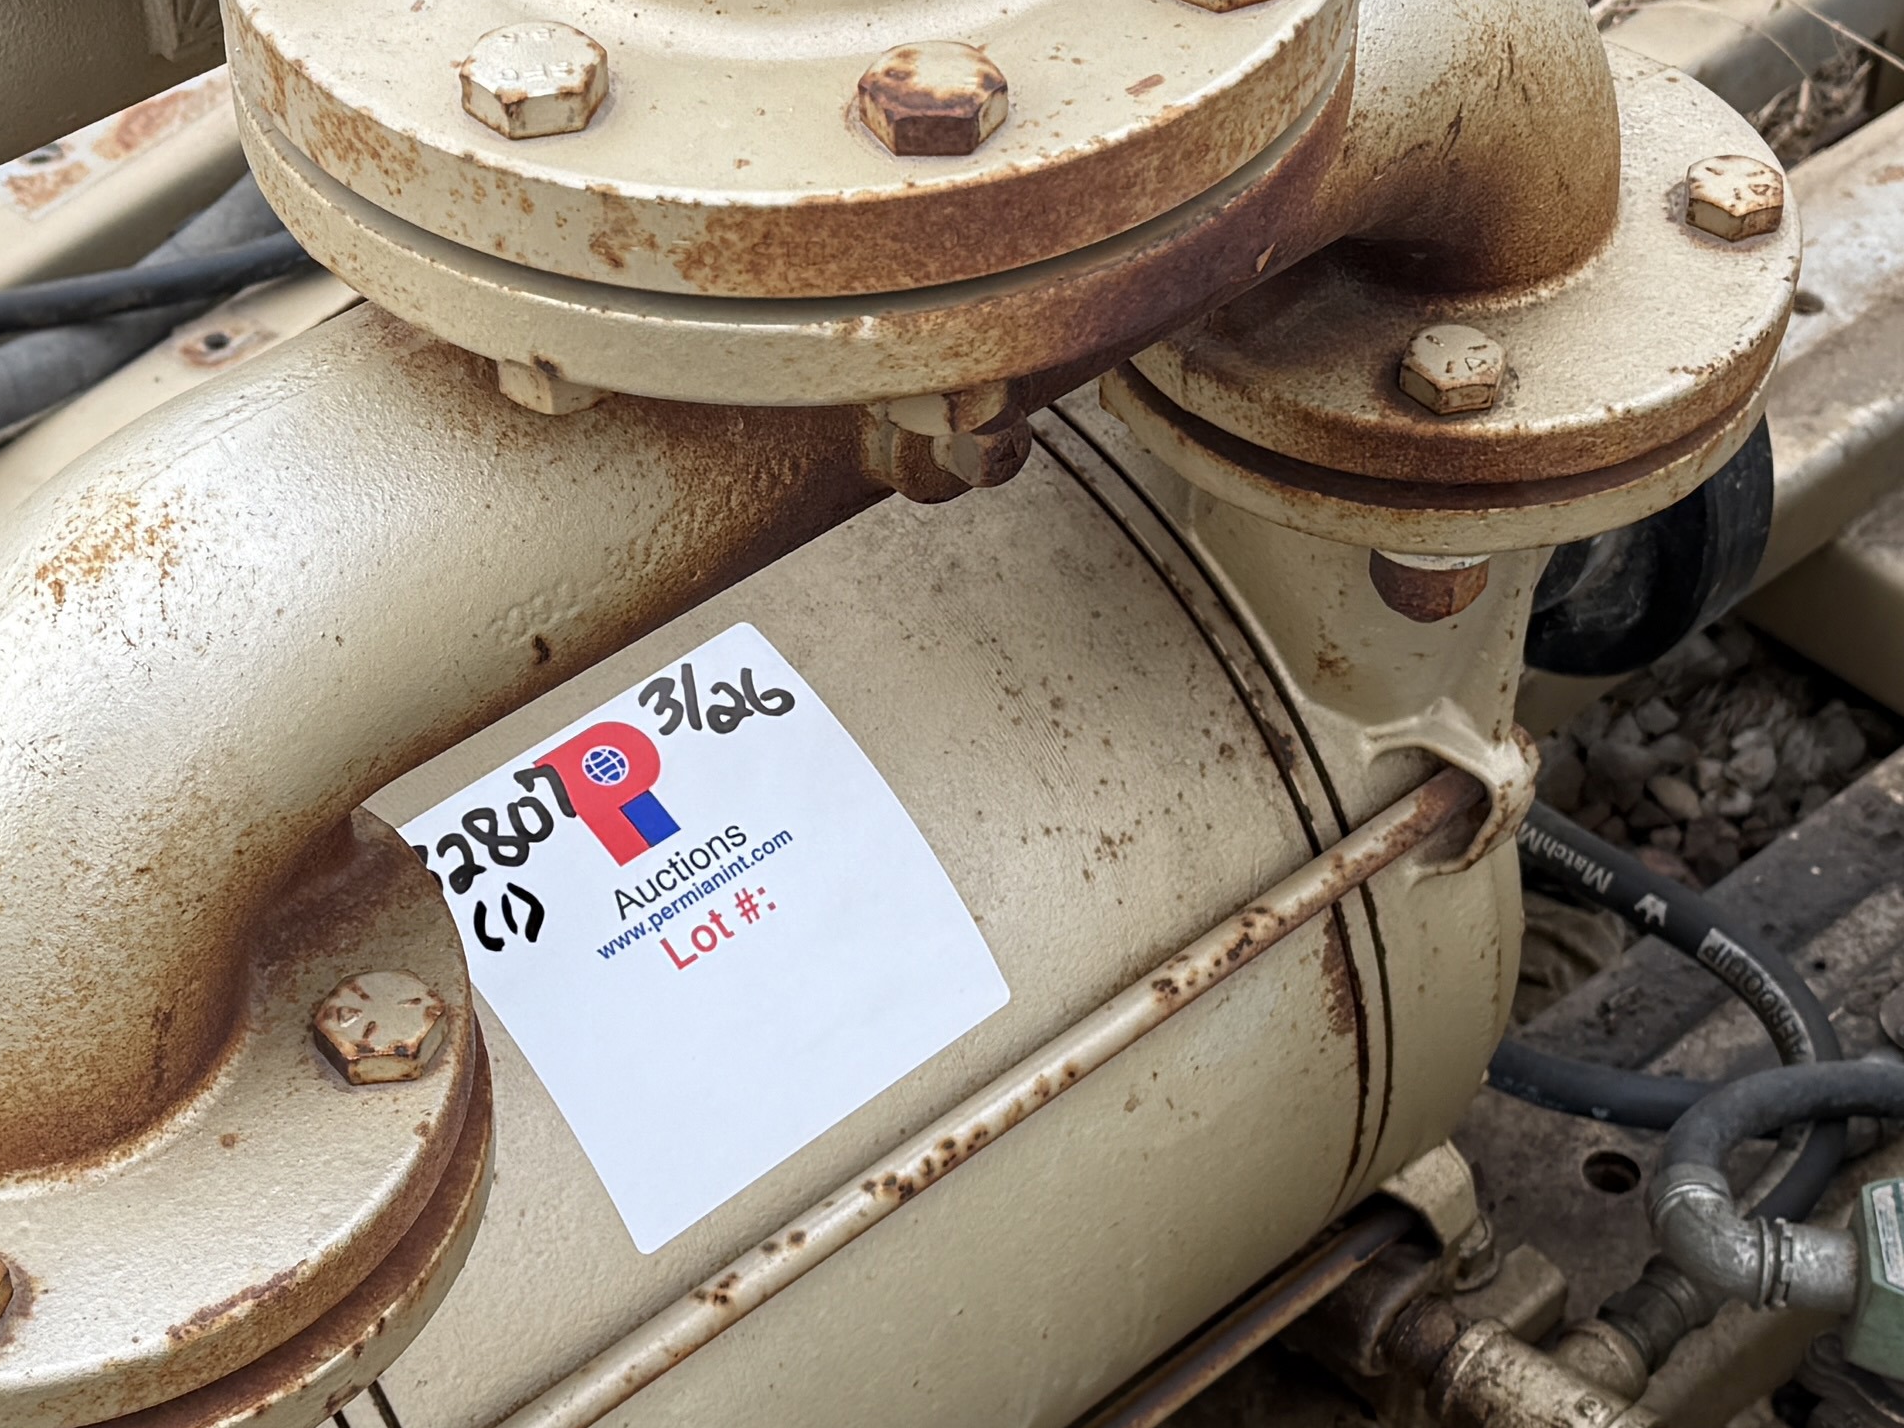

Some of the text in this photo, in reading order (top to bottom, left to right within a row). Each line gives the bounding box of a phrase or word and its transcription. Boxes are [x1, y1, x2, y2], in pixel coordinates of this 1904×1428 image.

[637, 663, 796, 736] 3/26
[596, 828, 794, 961] www.permianint.com
[612, 821, 748, 920] Auctions
[1518, 822, 1615, 895] MatchM
[658, 882, 778, 971] Lot #:
[1702, 941, 1809, 1060] AEROQUIP
